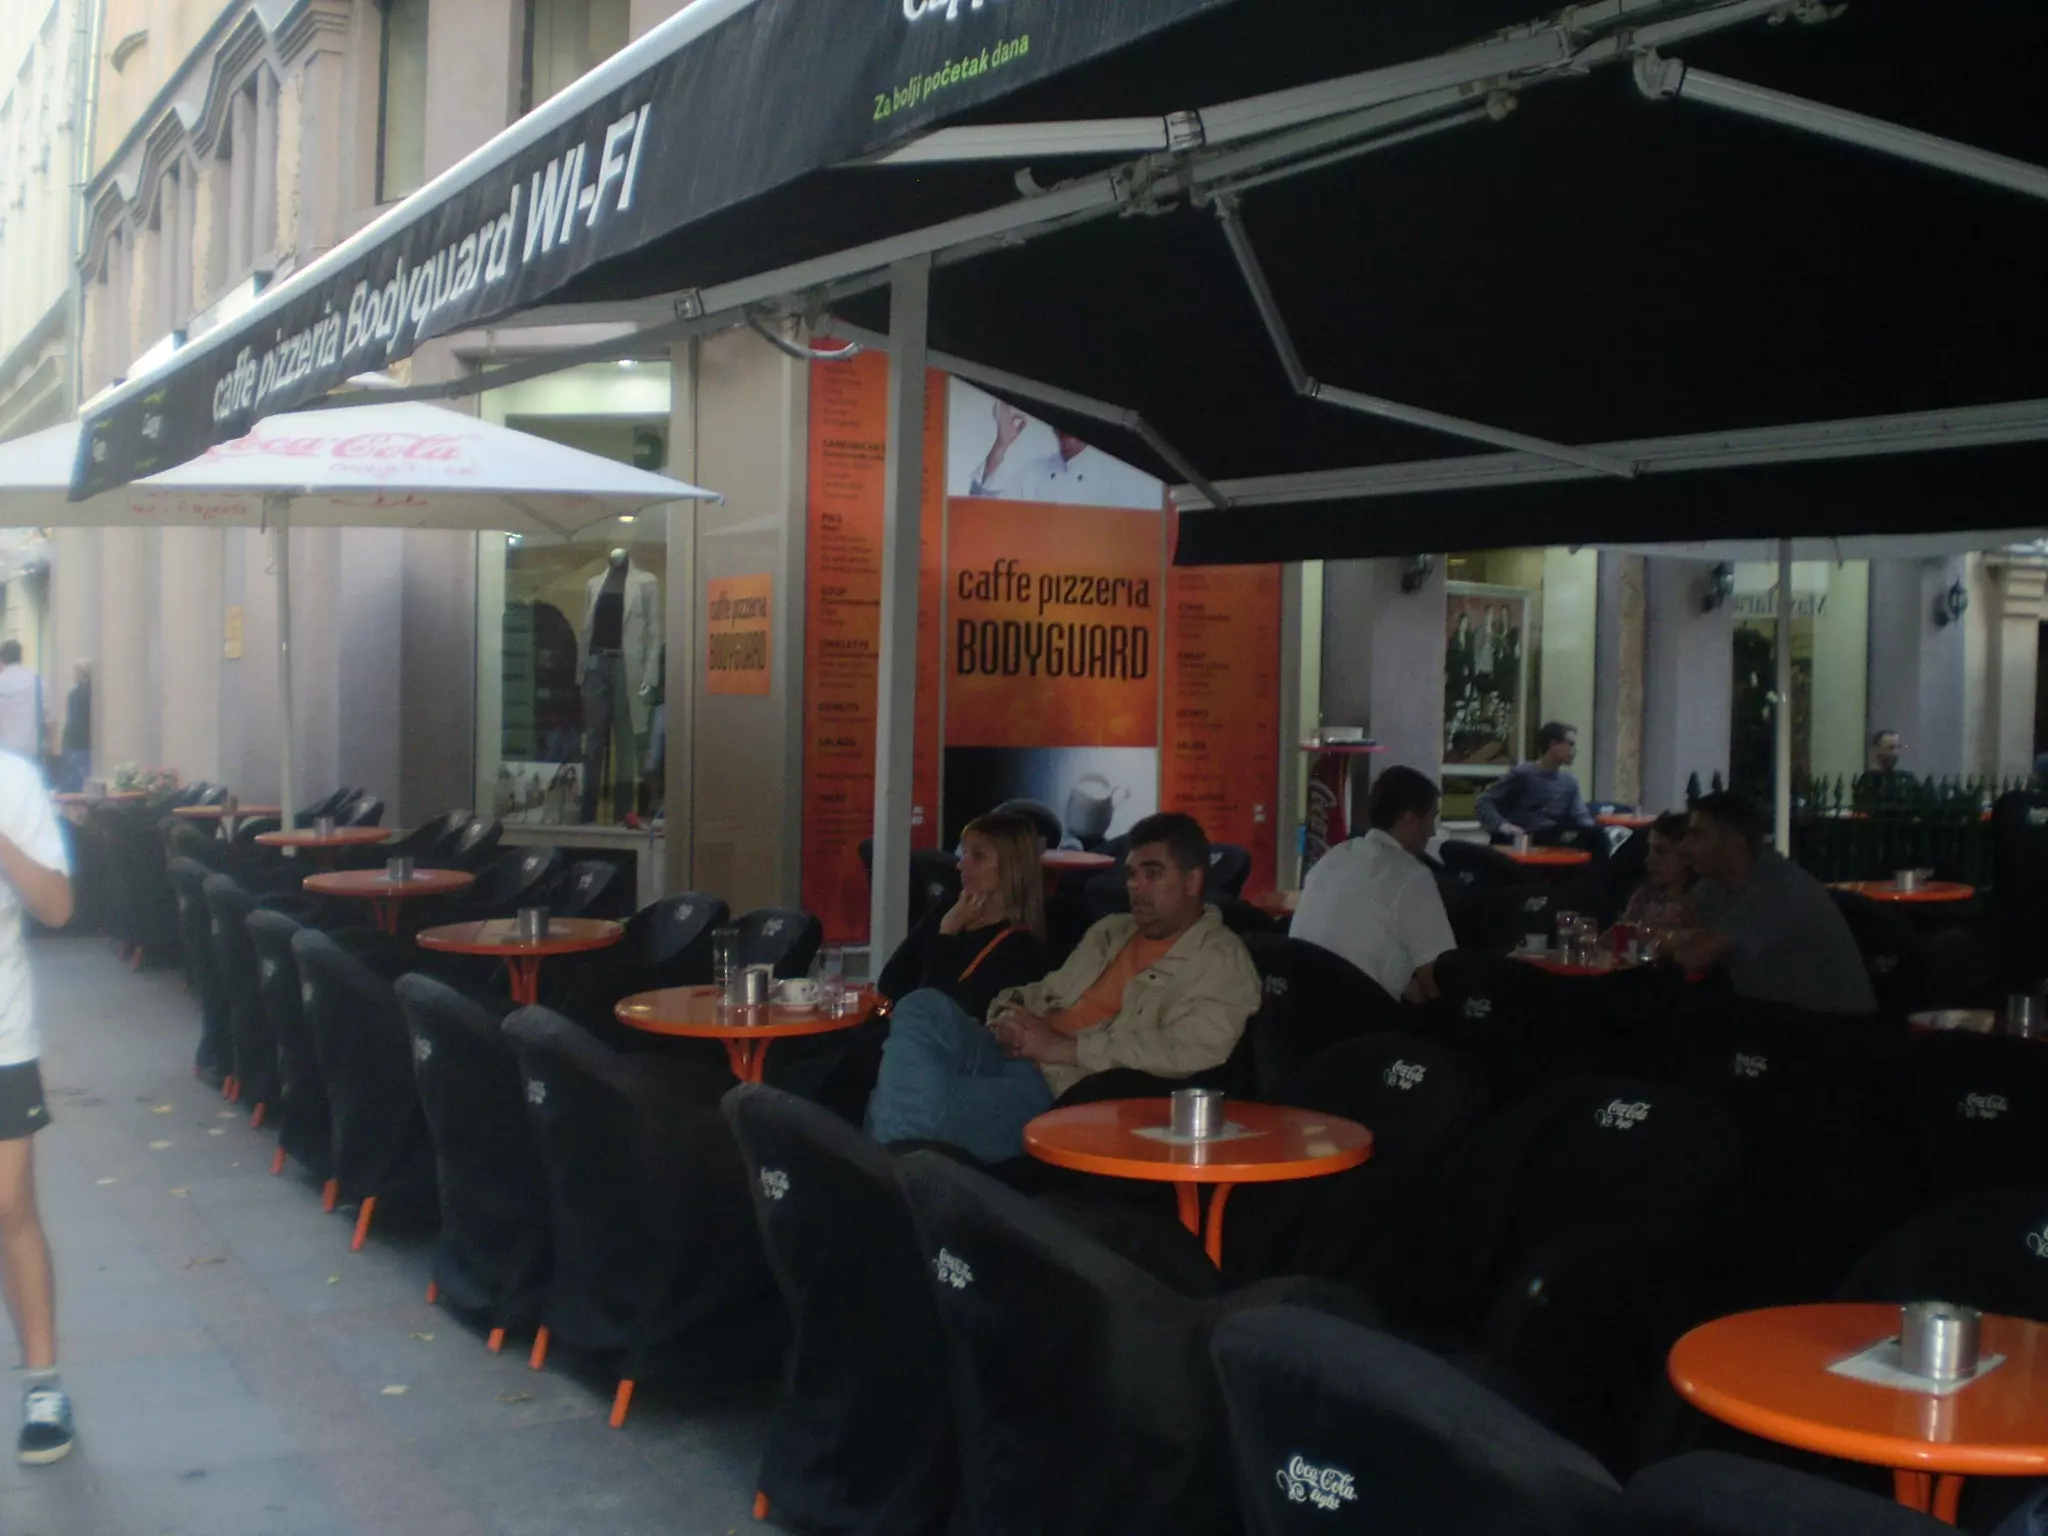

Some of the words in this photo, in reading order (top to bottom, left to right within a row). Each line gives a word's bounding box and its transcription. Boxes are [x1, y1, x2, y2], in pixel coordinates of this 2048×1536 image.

[873, 93, 892, 120] Za
[893, 74, 921, 110] bolji
[923, 47, 989, 100] početak
[991, 34, 1029, 68] dana
[213, 344, 256, 421] caffe
[254, 301, 342, 406] pizzeria
[342, 184, 520, 356] Bodyguard
[522, 103, 652, 263] WI-FI
[958, 557, 1031, 603] caffe
[1038, 574, 1149, 615] pizzeria
[956, 619, 1149, 680] BODYGUARD
